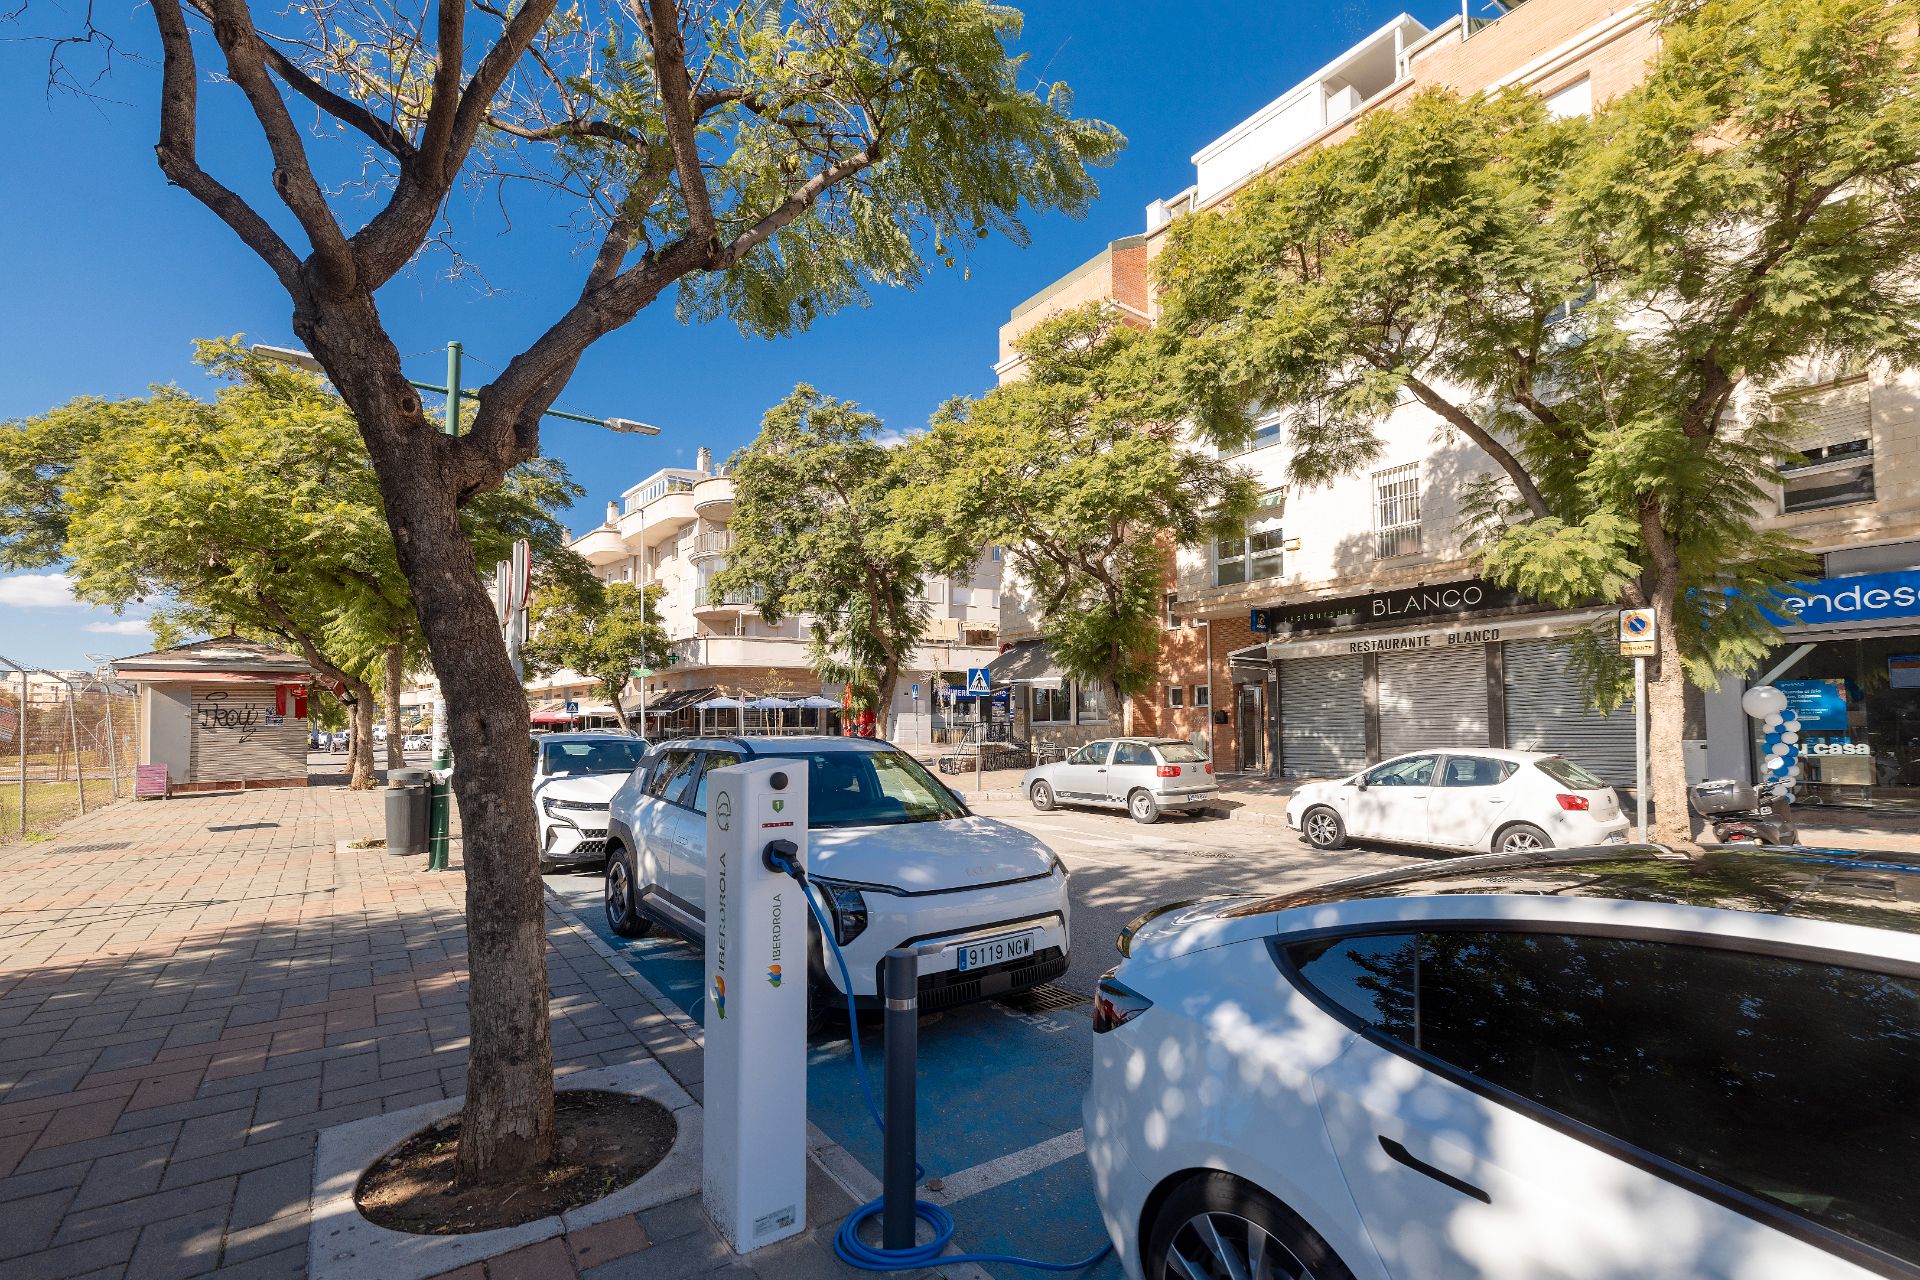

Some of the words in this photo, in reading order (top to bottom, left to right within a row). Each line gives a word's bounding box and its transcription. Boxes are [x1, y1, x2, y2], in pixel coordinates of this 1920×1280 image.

[1372, 586, 1483, 616] BLANCO
[1782, 584, 1920, 615] endes
[1349, 635, 1431, 653] RESTAURANTE
[1447, 628, 1500, 645] BLANCO
[1813, 743, 1871, 755] casa
[718, 852, 727, 972] IBERDROLA
[772, 893, 782, 961] IBERDROLA
[969, 943, 1003, 966] 9119
[1007, 937, 1030, 958] NGW
